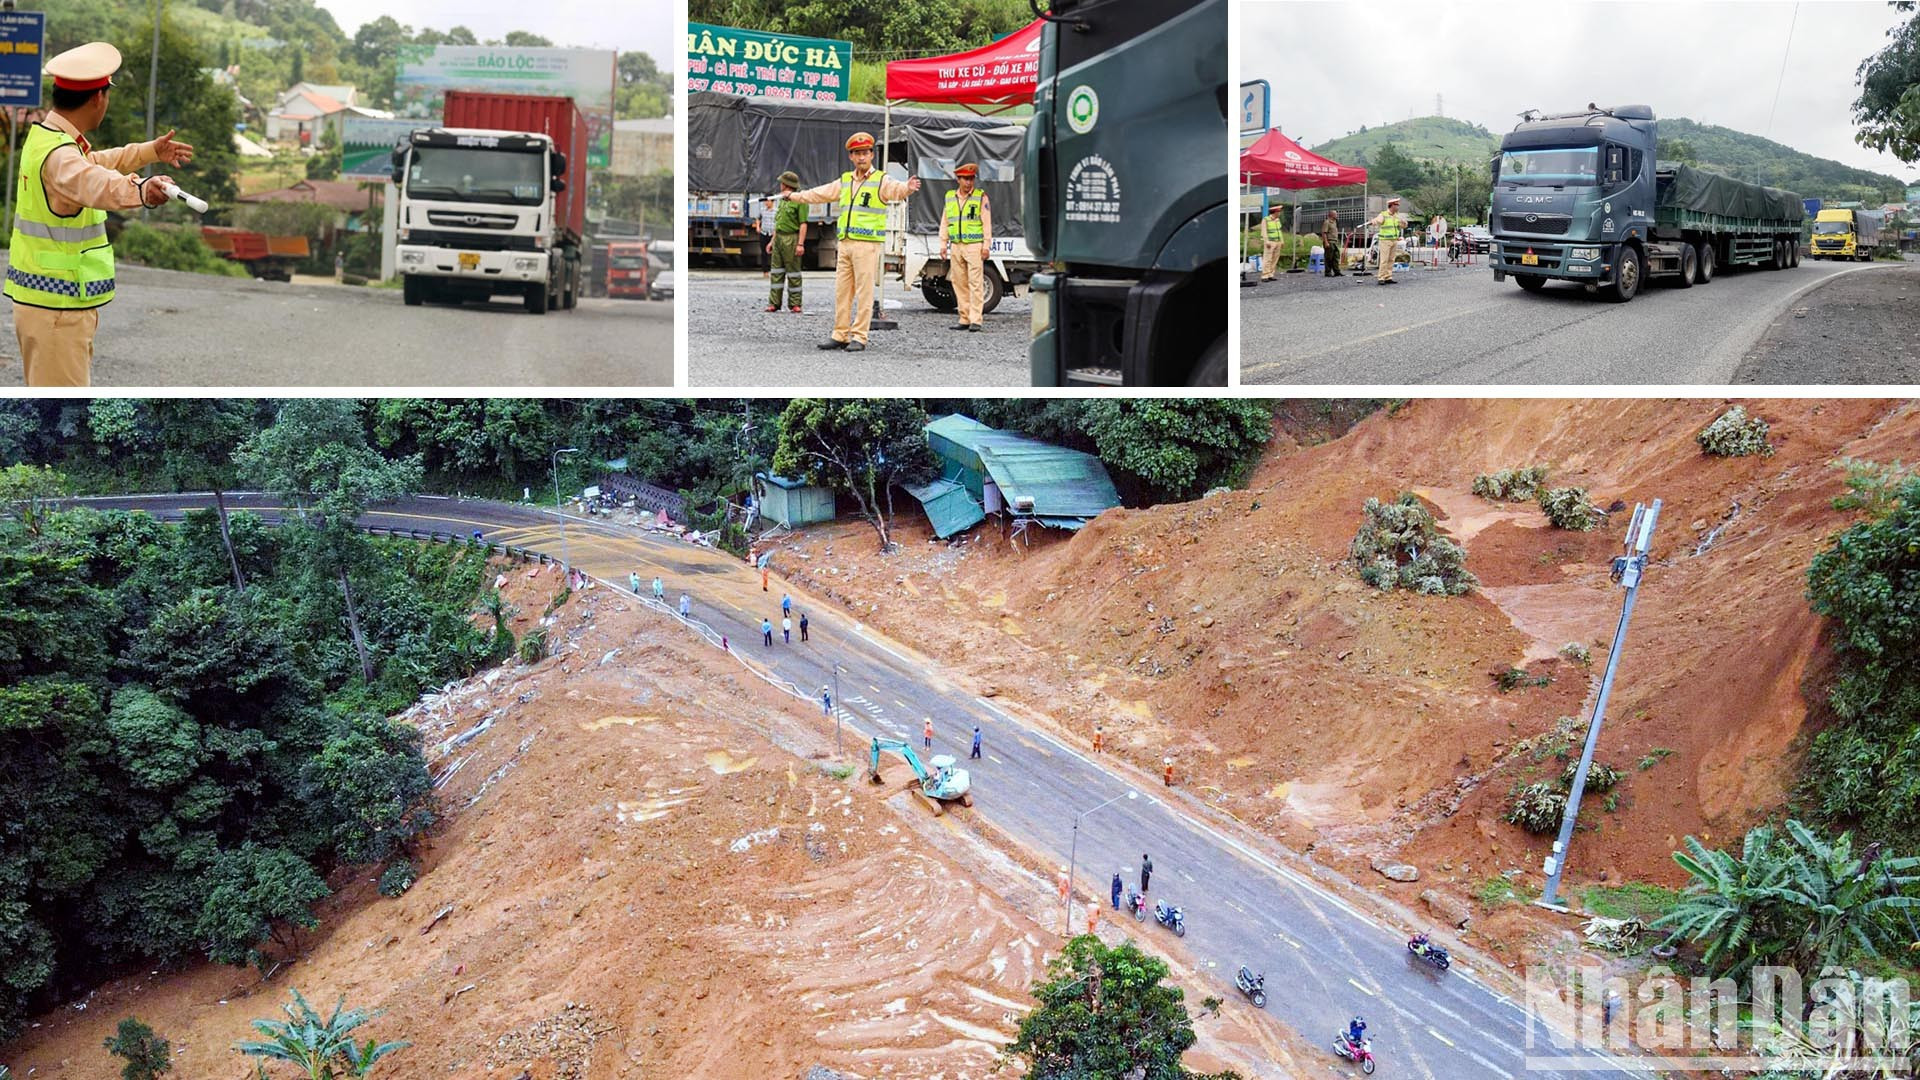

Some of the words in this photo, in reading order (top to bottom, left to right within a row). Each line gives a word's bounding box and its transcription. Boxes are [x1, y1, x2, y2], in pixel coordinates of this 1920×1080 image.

[478, 52, 506, 68] BẢO
[508, 54, 534, 71] LỘC
[744, 38, 800, 64] ĐỨC
[805, 45, 842, 69] HÀ
[714, 59, 727, 76] CÀ
[729, 62, 748, 78] PHÊ
[756, 65, 777, 82] TRÁI
[778, 66, 796, 83] CÂY
[803, 72, 820, 88] TẠP
[822, 72, 840, 88] HÓA
[938, 68, 955, 78] THU
[958, 67, 970, 78] XE
[1010, 63, 1022, 74] XE
[711, 80, 734, 94] 456
[736, 82, 757, 95] 799
[765, 86, 792, 98] 0965
[990, 239, 1001, 252] ẬT
